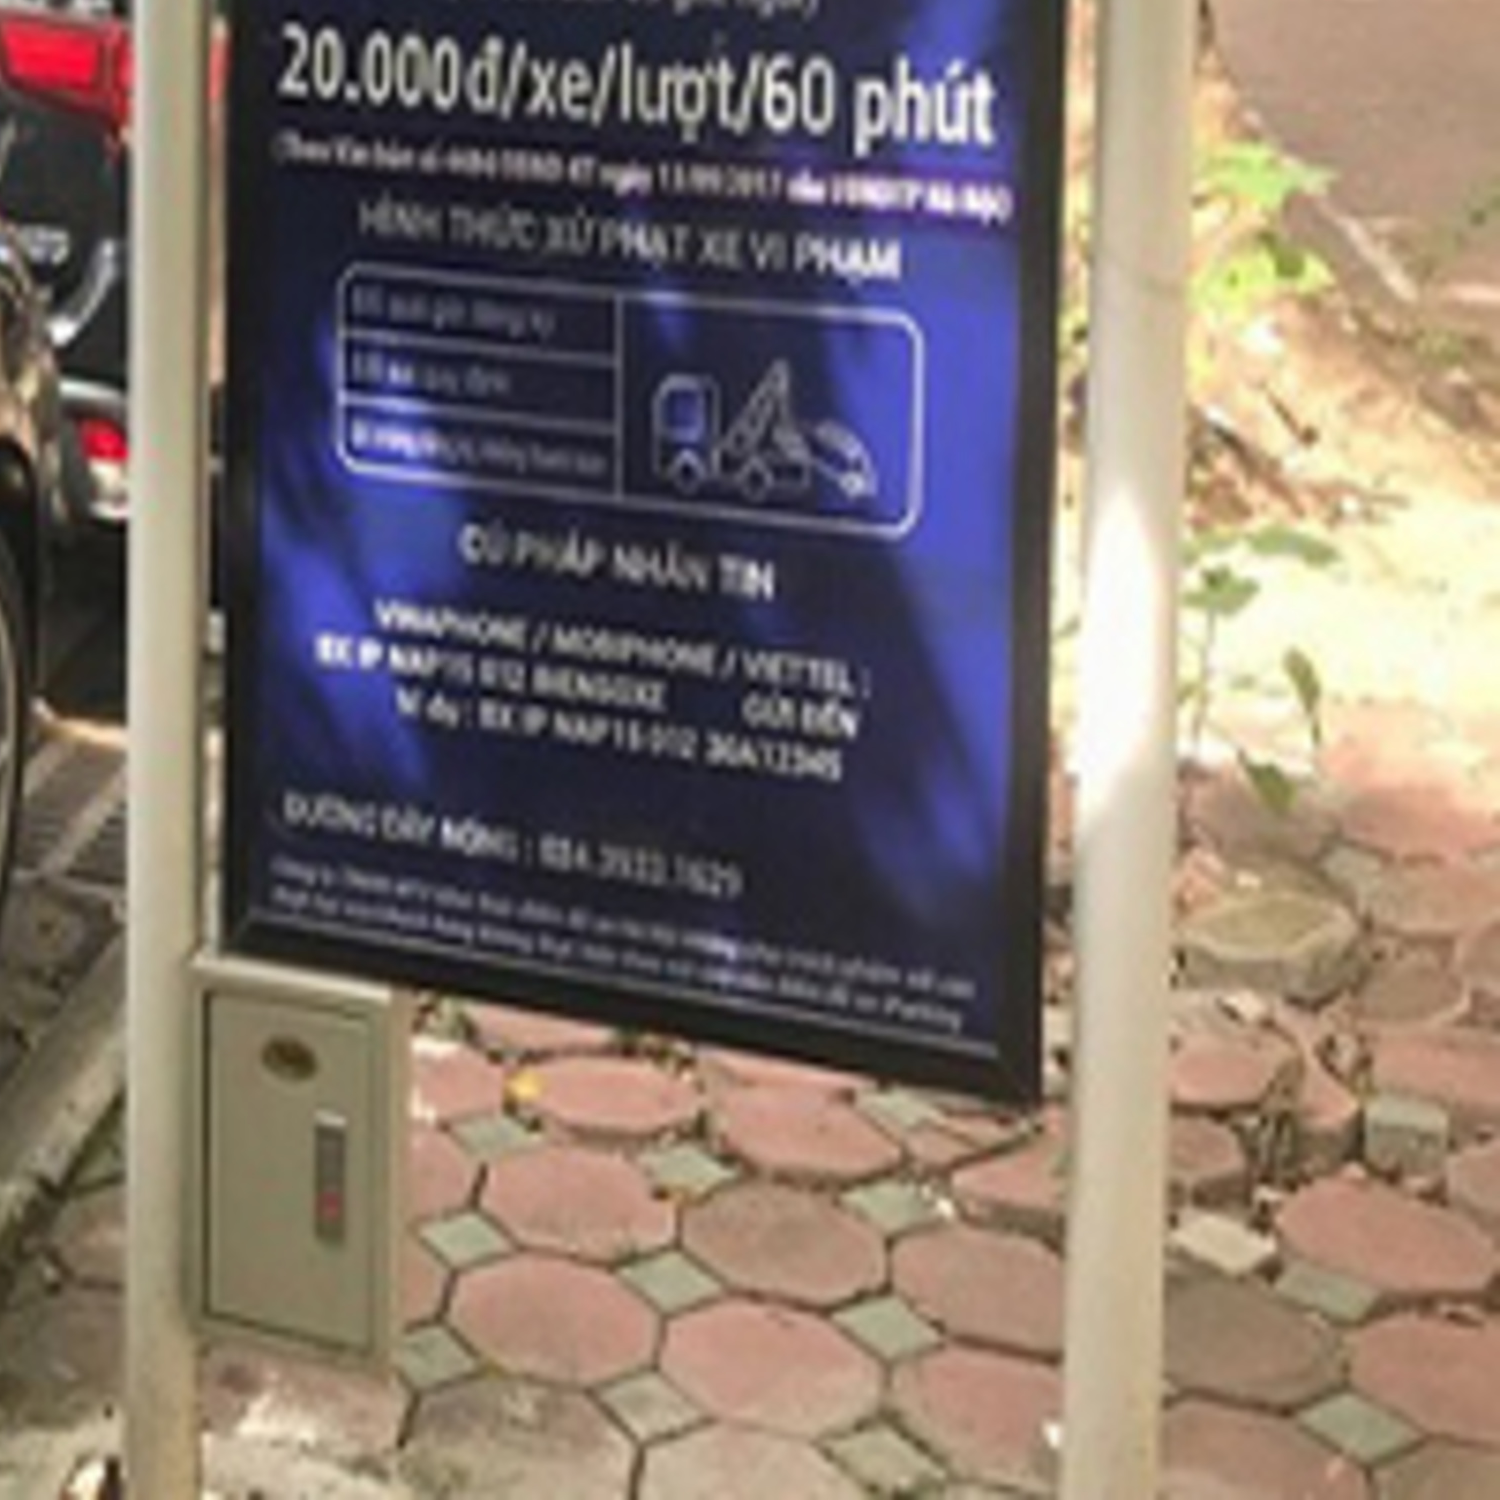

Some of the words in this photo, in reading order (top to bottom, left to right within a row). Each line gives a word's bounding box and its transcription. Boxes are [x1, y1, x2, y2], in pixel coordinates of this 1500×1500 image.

[276, 22, 837, 142] 20.000đ/xe/lượt/60
[852, 54, 997, 157] phút
[699, 227, 742, 269] XE
[750, 231, 787, 271] VI
